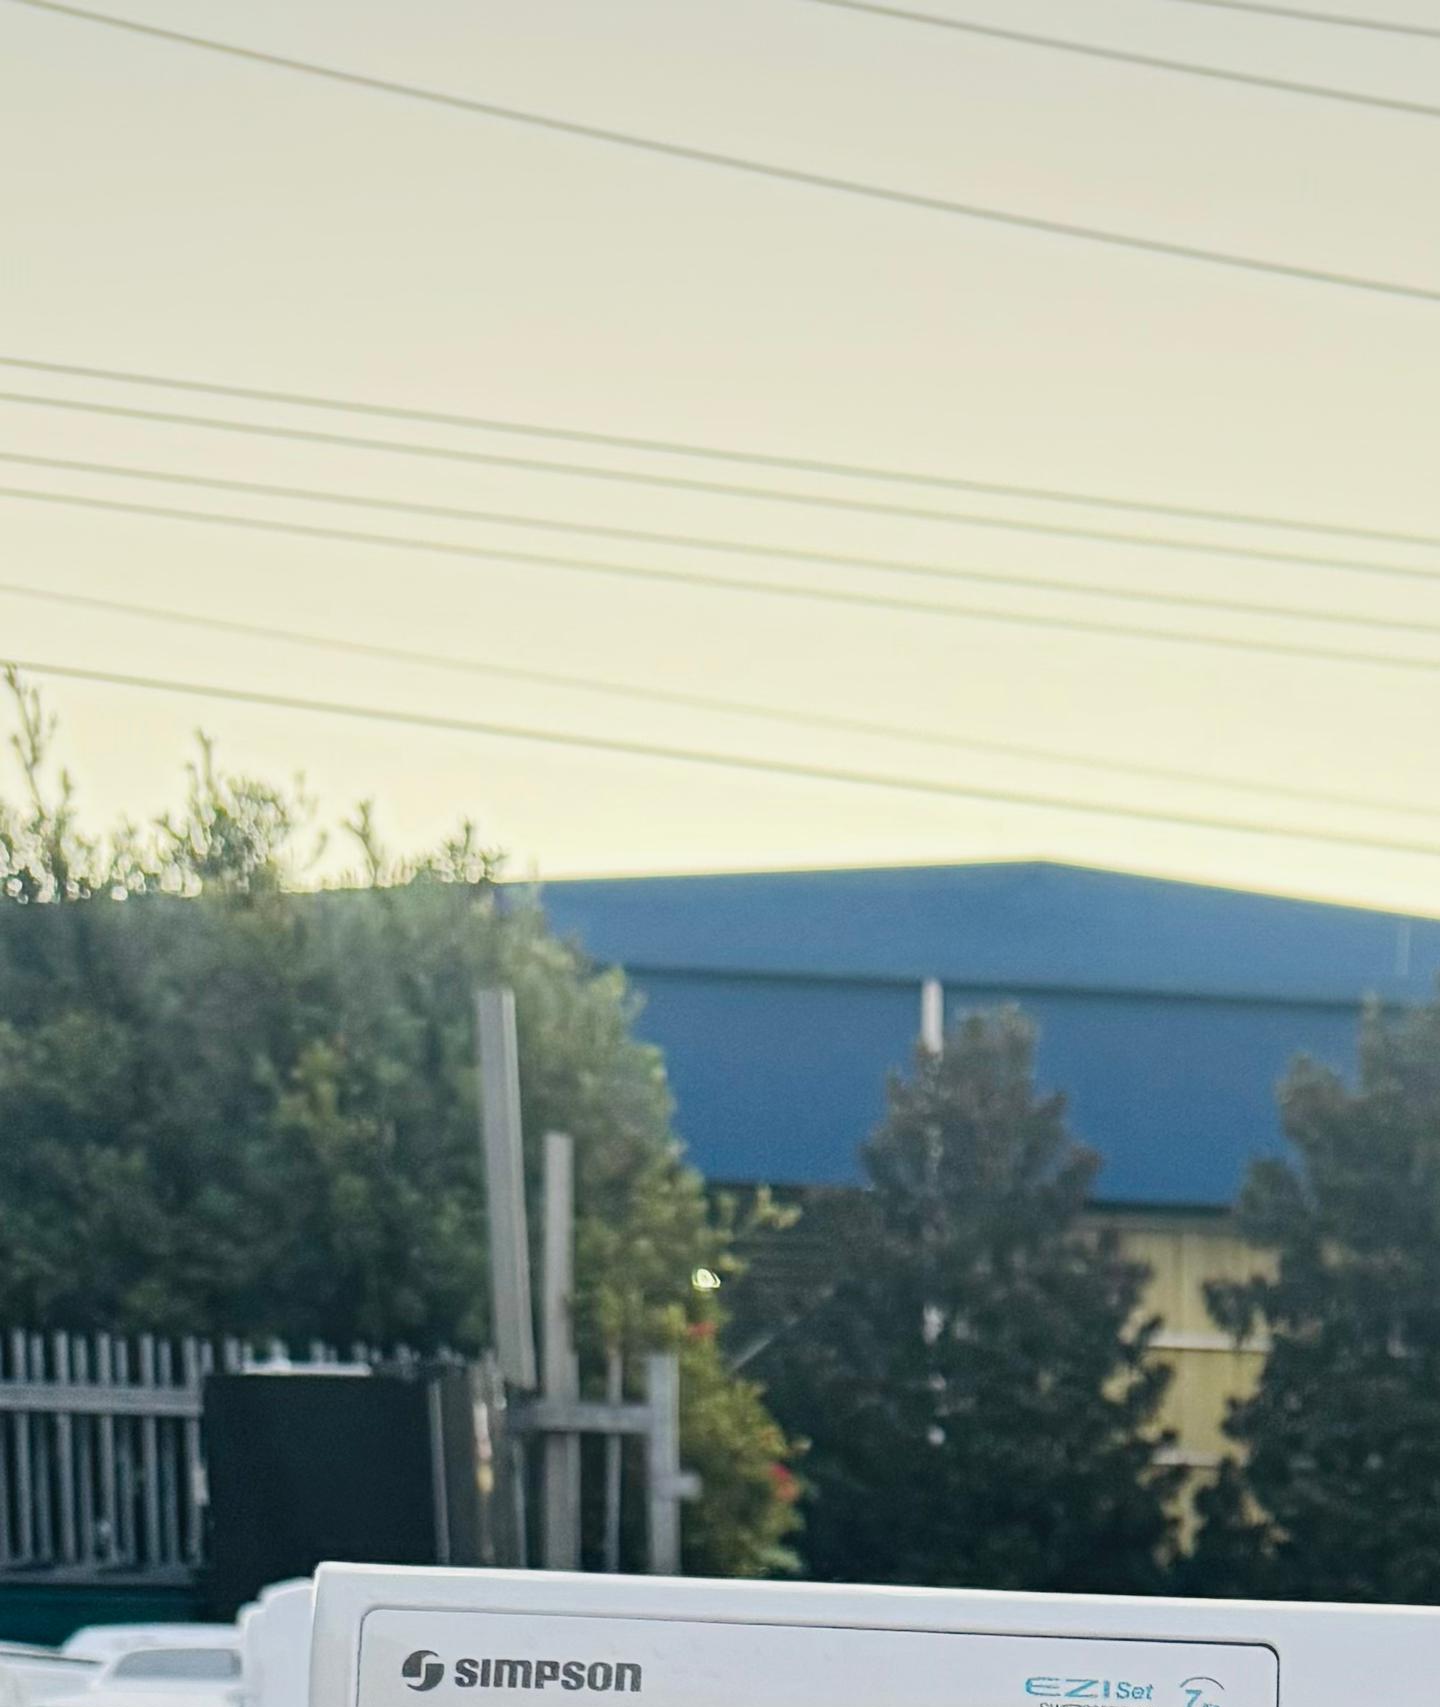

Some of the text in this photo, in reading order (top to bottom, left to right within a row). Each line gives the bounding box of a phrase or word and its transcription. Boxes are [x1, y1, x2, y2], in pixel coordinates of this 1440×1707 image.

[454, 1657, 643, 1693] SIMPSON
[1025, 1676, 1154, 1700] EZI Set
